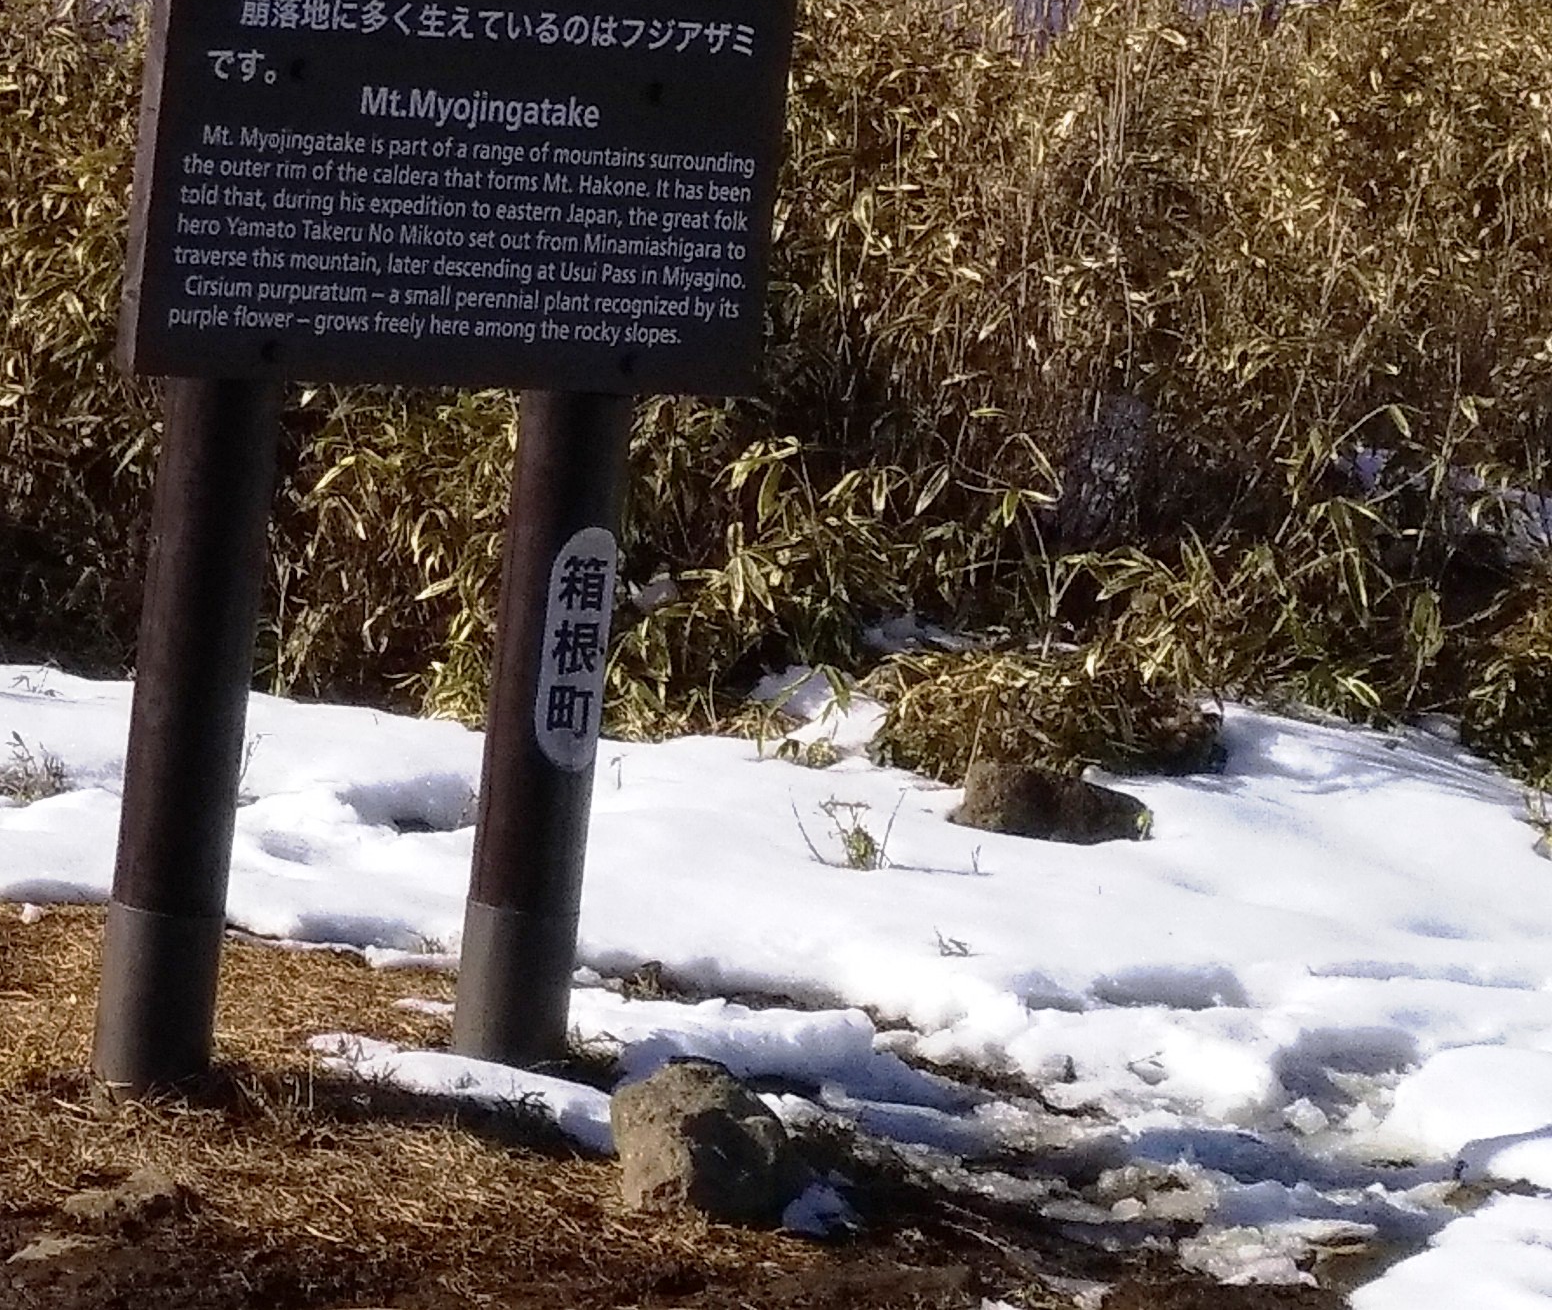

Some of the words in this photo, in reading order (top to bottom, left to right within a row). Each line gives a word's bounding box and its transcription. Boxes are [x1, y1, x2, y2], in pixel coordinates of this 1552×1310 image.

[207, 48, 277, 85] です。
[360, 86, 601, 132] Mt.Myojingatake
[203, 125, 233, 145] Mt.
[240, 127, 365, 155] Myojingatake
[372, 133, 384, 154] is
[389, 138, 427, 159] part
[433, 137, 453, 157] of
[473, 145, 524, 165] range
[530, 142, 549, 161] of
[554, 147, 645, 166] mountains
[650, 152, 754, 177] surrounding
[184, 154, 214, 175] the
[220, 159, 271, 177] outer
[277, 161, 306, 178] rim
[313, 160, 333, 180] of
[337, 162, 367, 182] the
[374, 165, 438, 186] caldera
[445, 167, 482, 188] that
[488, 169, 538, 191] forms
[545, 173, 572, 193] Mt.
[580, 175, 650, 197] Hakone.
[657, 179, 669, 197] It
[675, 179, 703, 199] has
[709, 180, 750, 201] been
[181, 185, 218, 204] told
[224, 187, 266, 210] that,
[273, 189, 333, 215] during
[340, 192, 365, 212] his
[370, 195, 465, 218] expedition
[472, 200, 490, 218] to
[496, 203, 561, 221] eastern
[566, 204, 622, 228] Japan,
[629, 207, 657, 226] the
[663, 212, 710, 232] great
[715, 210, 747, 231] folk
[178, 213, 220, 234] hero
[227, 217, 296, 238] Yamato
[302, 220, 363, 241] Takeru
[369, 224, 393, 243] No
[400, 225, 463, 246] Mikoto
[469, 230, 495, 248] set
[501, 233, 530, 249] out
[536, 230, 578, 251] from
[584, 234, 721, 262] Minamiashigara
[728, 242, 745, 259] to
[174, 246, 246, 266] traverse
[252, 247, 284, 268] this
[290, 252, 381, 275] mountain,
[388, 253, 429, 274] later
[434, 255, 531, 284] descending
[537, 263, 555, 280] at
[561, 262, 596, 281] Usui
[602, 264, 636, 283] Pass
[642, 266, 657, 284] in
[663, 266, 745, 291] Miyagino.
[186, 275, 251, 297] Cirsium
[258, 283, 366, 304] purpuratum
[405, 286, 450, 305] small
[456, 289, 539, 311] perennial
[544, 291, 590, 315] plant
[595, 296, 689, 318] recognized
[694, 297, 715, 322] by
[720, 298, 739, 318] its
[169, 305, 228, 329] purple
[234, 306, 294, 327] flower
[315, 315, 368, 335] grows
[375, 312, 425, 339] freely
[430, 315, 469, 335] here
[475, 322, 535, 343] among
[541, 320, 569, 339] the
[575, 322, 621, 346] rocky
[625, 324, 681, 347] slopes.
[547, 555, 609, 738] 箱根町
